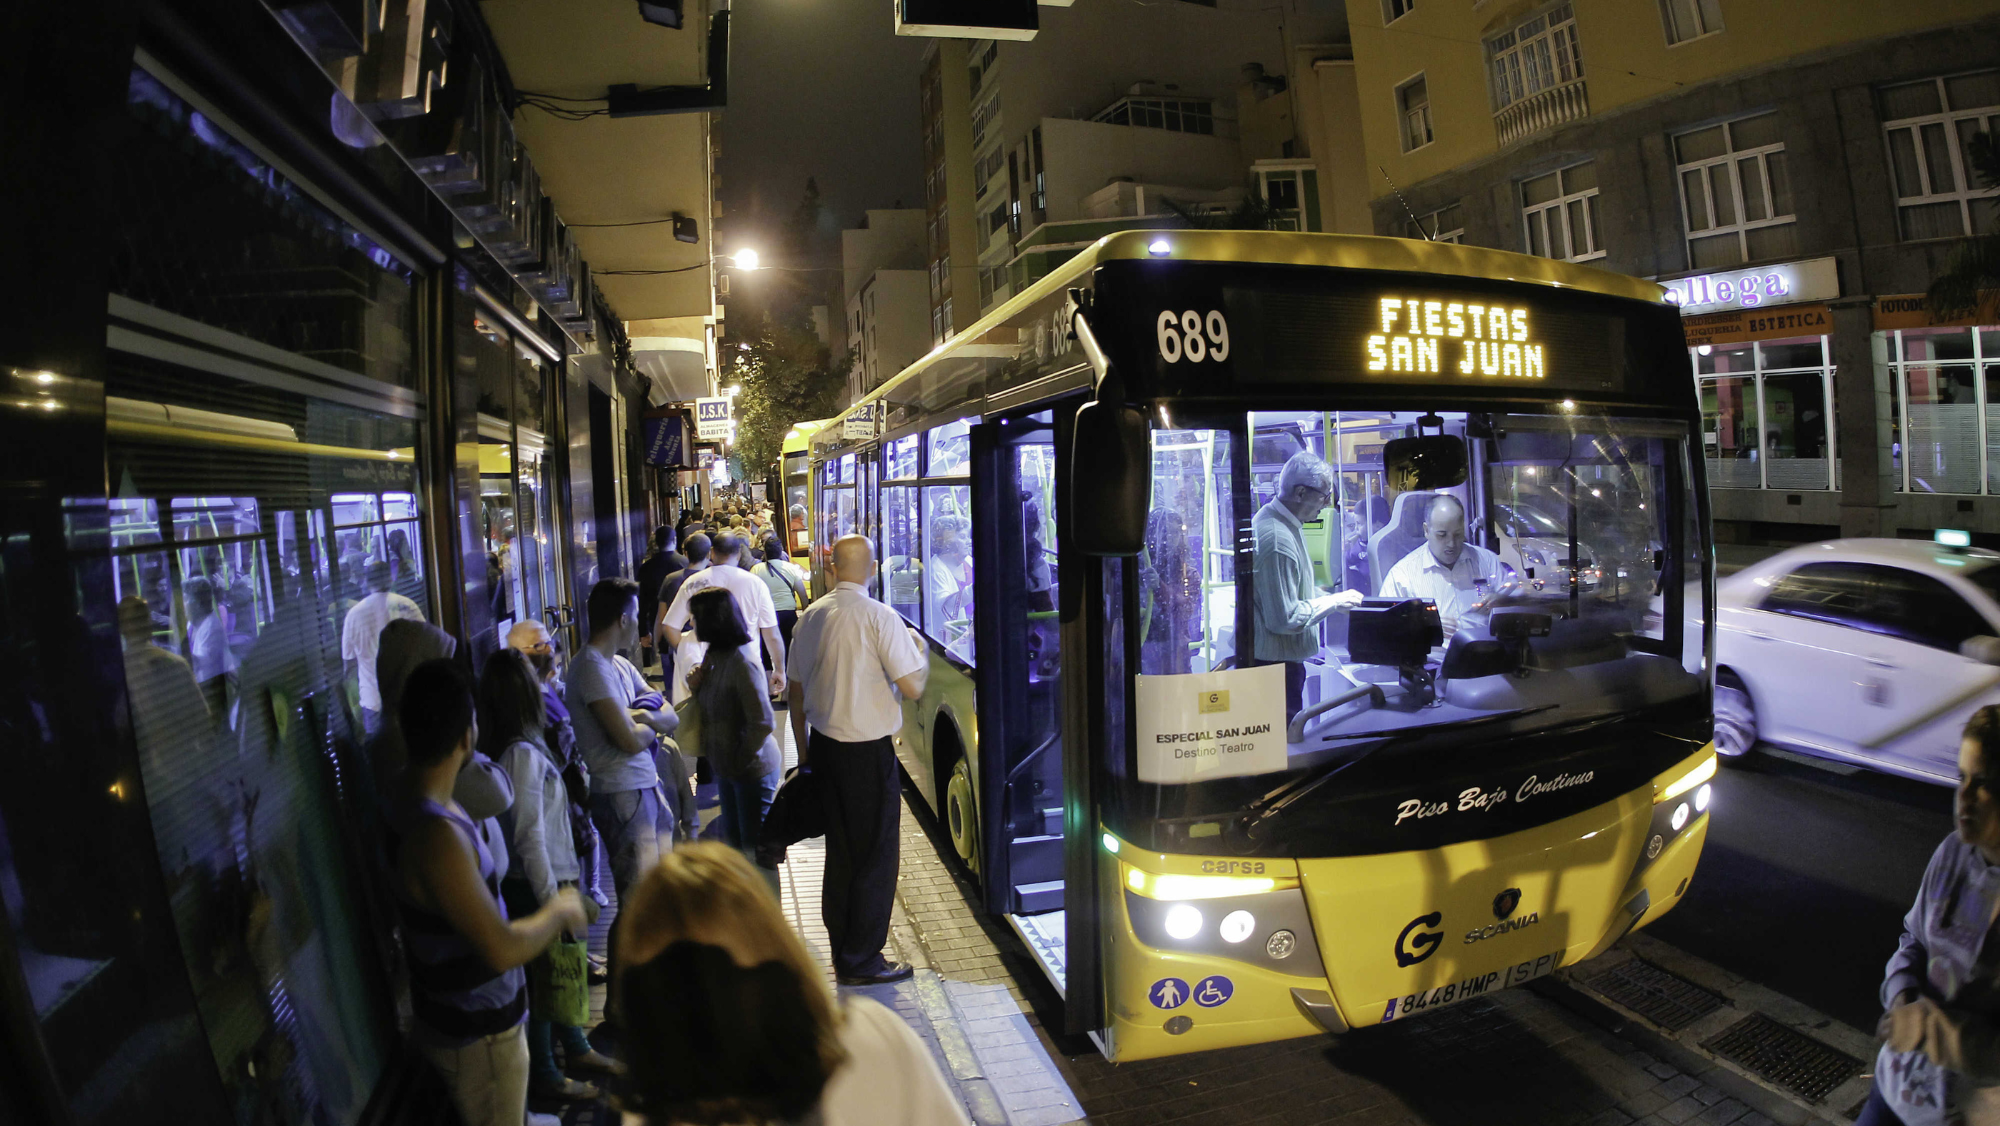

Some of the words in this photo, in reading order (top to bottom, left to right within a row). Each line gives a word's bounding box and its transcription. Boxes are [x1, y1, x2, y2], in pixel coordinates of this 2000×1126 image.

[1380, 297, 1529, 341] FIESTAS
[1682, 314, 1742, 327] AIRDRESSER
[1749, 312, 1826, 333] ESTETICA
[1156, 310, 1230, 363] 689
[1685, 325, 1742, 338] LUQUERIA
[1687, 336, 1714, 347] ISEX
[1367, 335, 1439, 372] SAN
[1459, 339, 1543, 378] JUAN
[700, 403, 728, 420] J.S.K.
[701, 428, 729, 436] BABITA
[1156, 731, 1213, 745] ESPECIAL
[1215, 727, 1241, 740] SAN
[1241, 723, 1271, 736] JUAN
[1174, 746, 1217, 759] Destino
[1219, 741, 1255, 755] Teatro
[1394, 798, 1449, 826] Piso
[1457, 787, 1508, 812] Bajo
[1515, 770, 1594, 803] Continuo
[1201, 859, 1266, 875] carsa
[1463, 912, 1539, 945] SCANIA
[1401, 983, 1455, 1014] 8448
[1458, 971, 1498, 999] HMP
